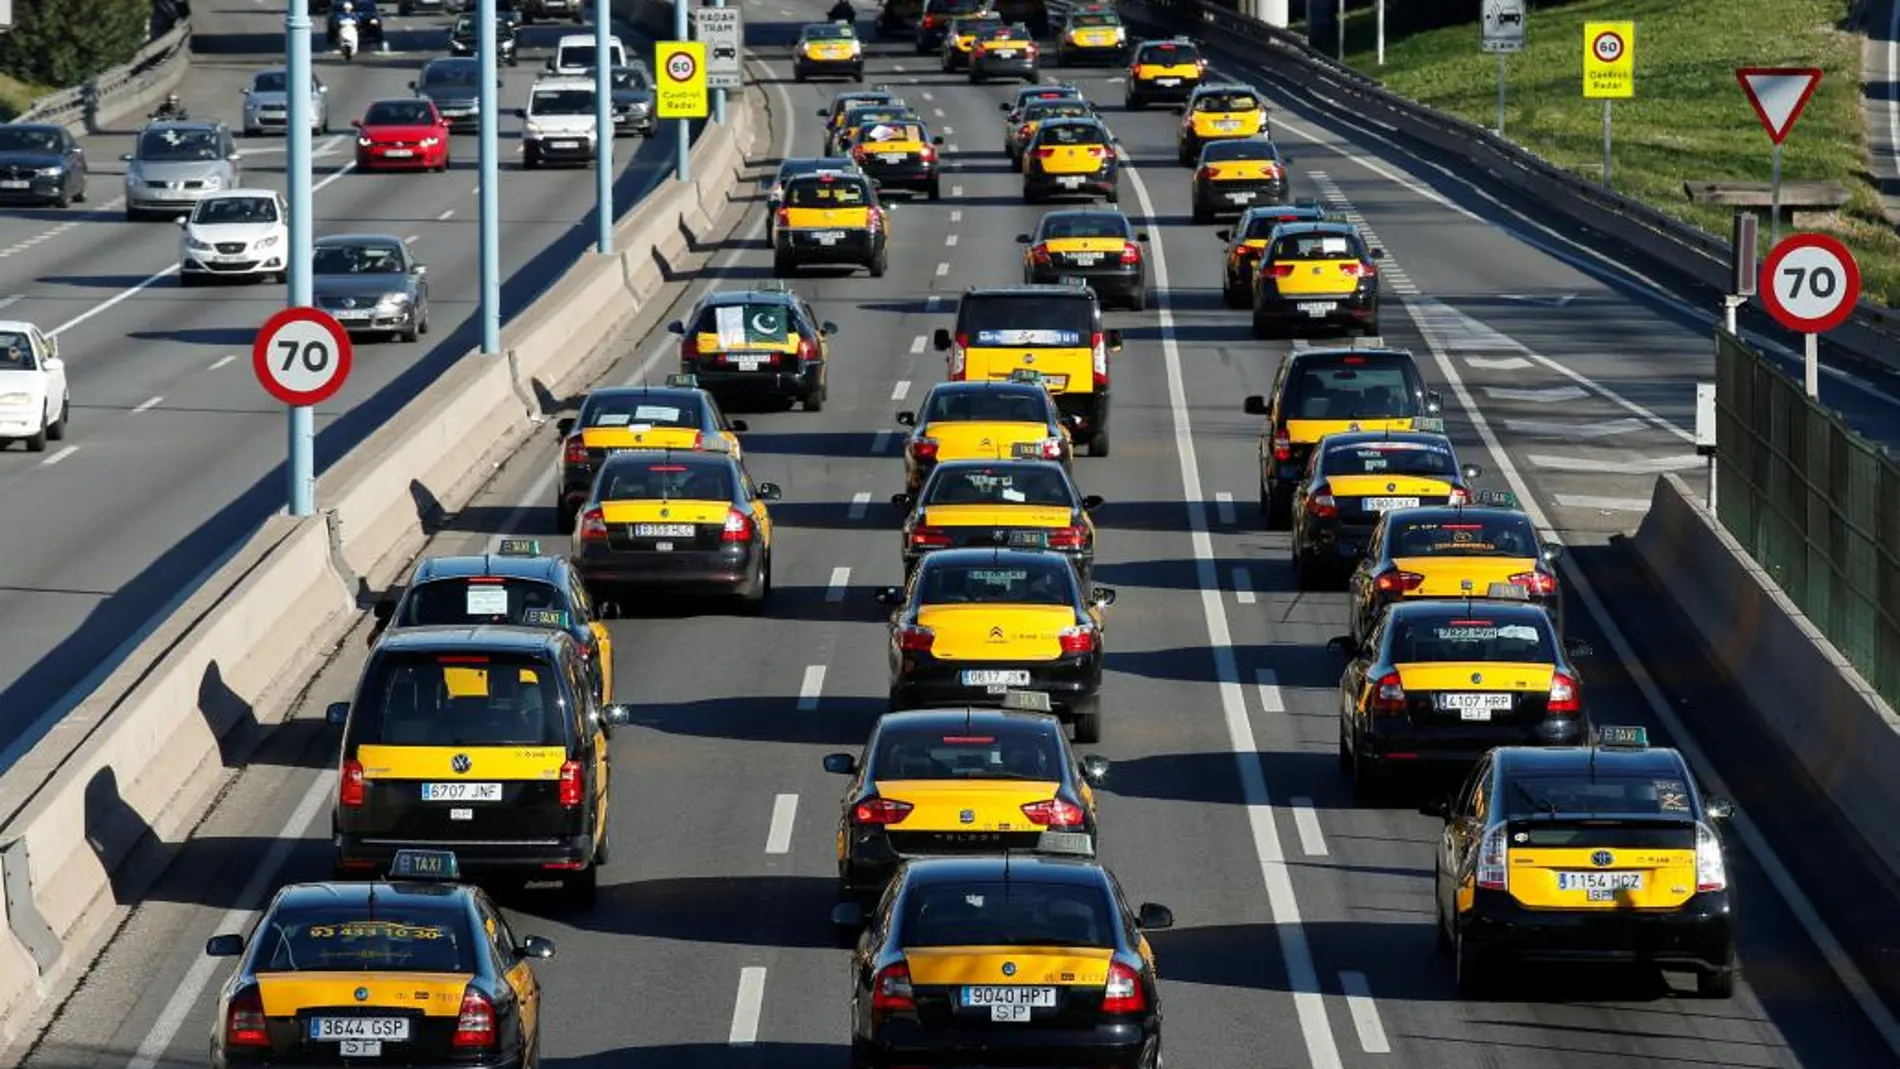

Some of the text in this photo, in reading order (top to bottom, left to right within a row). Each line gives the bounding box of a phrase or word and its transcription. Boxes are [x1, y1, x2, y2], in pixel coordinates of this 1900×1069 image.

[700, 13, 736, 21] RADAR
[703, 23, 733, 32] TRAM
[1600, 42, 1618, 52] 60
[672, 62, 690, 72] 60
[1590, 71, 1629, 80] Control
[1593, 82, 1622, 90] Radar
[662, 90, 700, 99] Control
[667, 101, 696, 109] Radar
[1783, 266, 1836, 299] 70
[277, 340, 329, 373] 70
[1448, 695, 1509, 707] 4107 HRP
[431, 784, 497, 798] 6707 JNF
[413, 856, 442, 872] TAXI
[1570, 875, 1639, 889] 1154 HCZ
[973, 987, 1051, 1004] 9040 HPT
[996, 1005, 1027, 1020] SP
[323, 1019, 403, 1036] 3644 GSP
